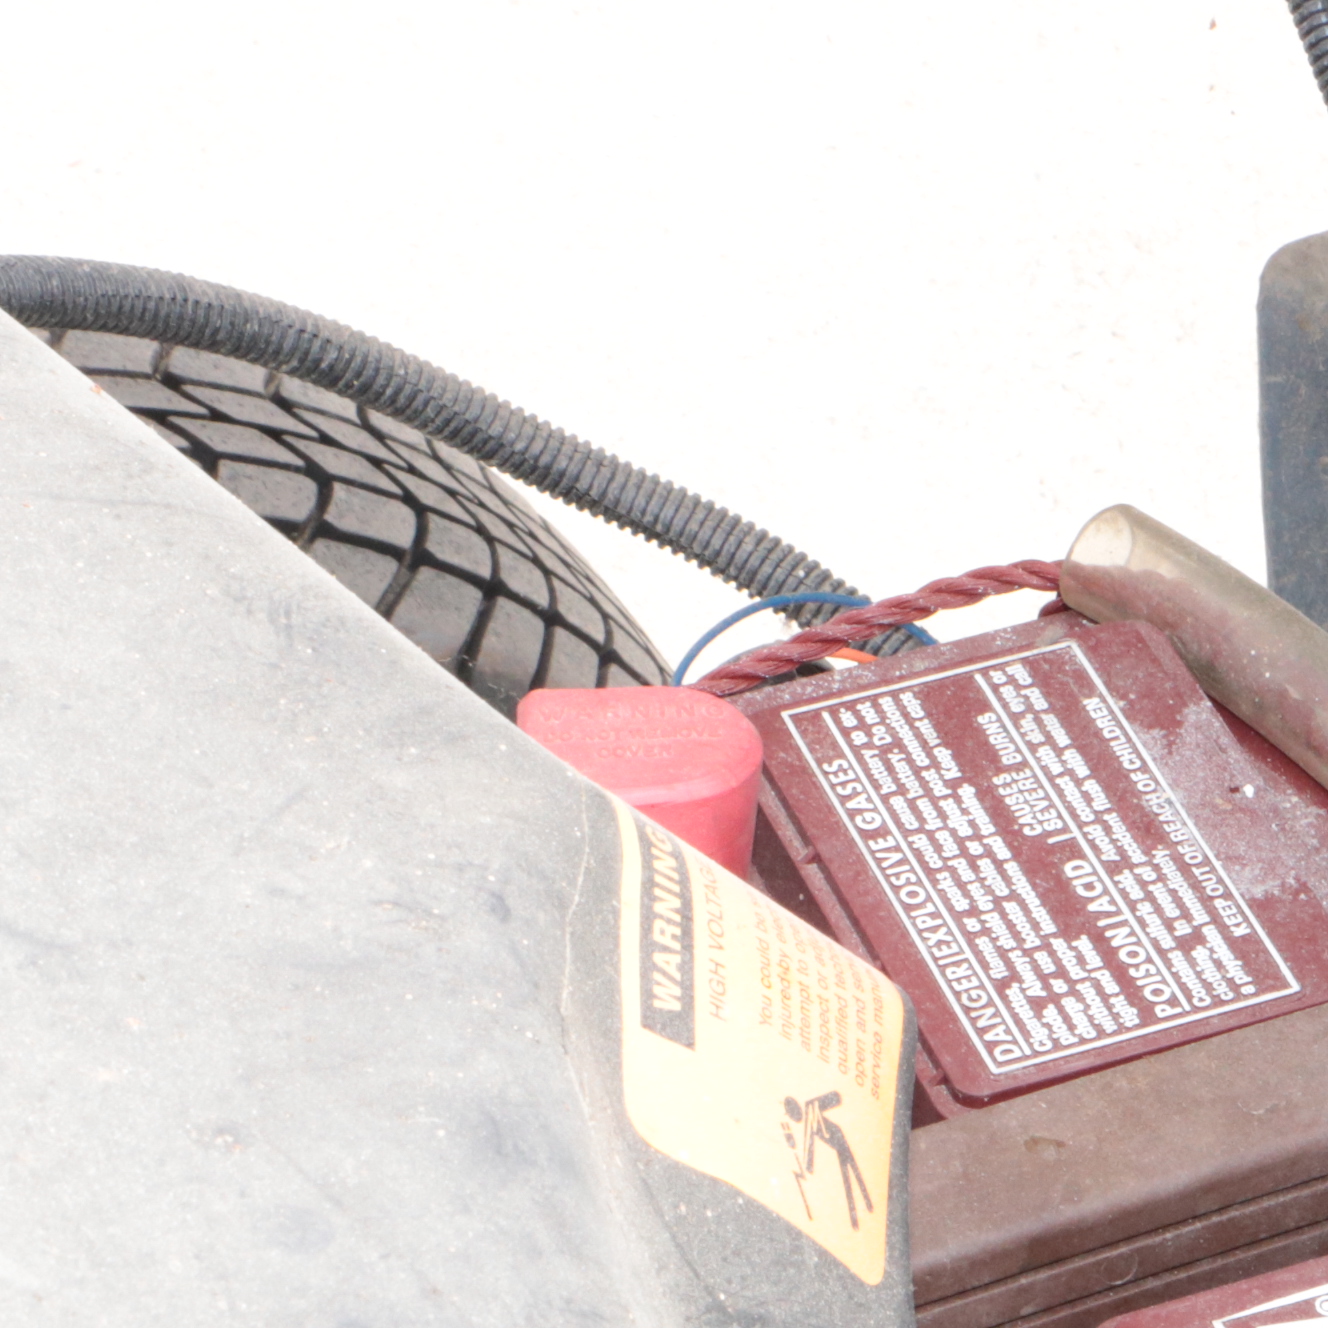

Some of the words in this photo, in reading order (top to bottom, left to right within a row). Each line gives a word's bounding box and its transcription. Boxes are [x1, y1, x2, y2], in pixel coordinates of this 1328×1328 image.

[987, 669, 1008, 685] or
[1003, 662, 1033, 686] call
[854, 700, 881, 725] not
[898, 690, 925, 719] caps
[998, 683, 1026, 713] eyes
[1018, 685, 1049, 711] and
[849, 729, 869, 746] to
[870, 723, 893, 746] Do
[876, 695, 931, 767] connections
[912, 717, 941, 747] vent
[975, 711, 1023, 765] BURNS
[1038, 712, 1072, 748] water
[1081, 695, 1142, 770] CHILDREN
[859, 748, 898, 795] battery
[931, 745, 962, 780] Keep
[1034, 743, 1065, 776] with
[1059, 747, 1091, 779] with
[821, 757, 883, 830] GASES
[919, 767, 953, 797] post
[1009, 766, 1064, 832] SEVERE
[1053, 774, 1096, 823] contact
[1079, 777, 1112, 811] flush
[1128, 770, 1157, 792] OF
[887, 794, 920, 830] cause
[914, 796, 944, 831] from
[937, 796, 974, 838] adjust
[990, 772, 1044, 836] CAUSES
[1141, 789, 1193, 842] REACH
[906, 832, 944, 869] could
[933, 828, 961, 858] face
[963, 839, 985, 856] or
[981, 834, 1012, 861] and
[1081, 822, 1121, 861] Avoid
[1101, 810, 1150, 864] accident
[1175, 837, 1204, 865] OF
[945, 856, 977, 883] and
[975, 856, 1011, 897] cables
[1062, 858, 1118, 912] ACID
[1131, 864, 1158, 882] of
[1190, 865, 1224, 897] OUT
[698, 857, 726, 951] VOLTAG
[866, 834, 961, 958] EXPLOSIVE
[934, 870, 971, 912] sparks
[965, 880, 995, 912] eyes
[1001, 859, 1058, 936] instructions
[1146, 880, 1181, 918] event
[645, 825, 682, 1012] WARNING
[961, 916, 982, 933] or
[978, 910, 1018, 950] shield
[1000, 900, 1042, 949] booster
[1134, 900, 1177, 950] sulfuric
[1172, 918, 1193, 937] In
[1212, 896, 1252, 937] KEEP
[756, 937, 772, 989] could
[797, 959, 810, 977] to
[973, 934, 1010, 980] flames
[1006, 948, 1048, 997] Always
[1031, 949, 1057, 974] use
[1047, 936, 1090, 980] proper
[1103, 924, 1184, 1019] POISON
[1200, 923, 1253, 985] physician
[709, 958, 727, 1022] HIGH
[817, 972, 829, 990] or
[1047, 977, 1069, 994] or
[1088, 968, 1121, 995] and
[1166, 948, 1212, 1008] Contains
[1239, 983, 1256, 995] a
[759, 995, 773, 1027] You
[777, 973, 794, 1041] injured
[798, 981, 814, 1053] attempt
[852, 995, 866, 1032] and
[943, 961, 1024, 1063] DANGER
[1059, 995, 1098, 1040] charge
[1074, 979, 1118, 1034] without
[1107, 993, 1140, 1028] tight
[816, 994, 833, 1064] inspect
[834, 993, 850, 1076] qualified
[854, 1038, 868, 1088] open
[871, 1031, 884, 1101] service
